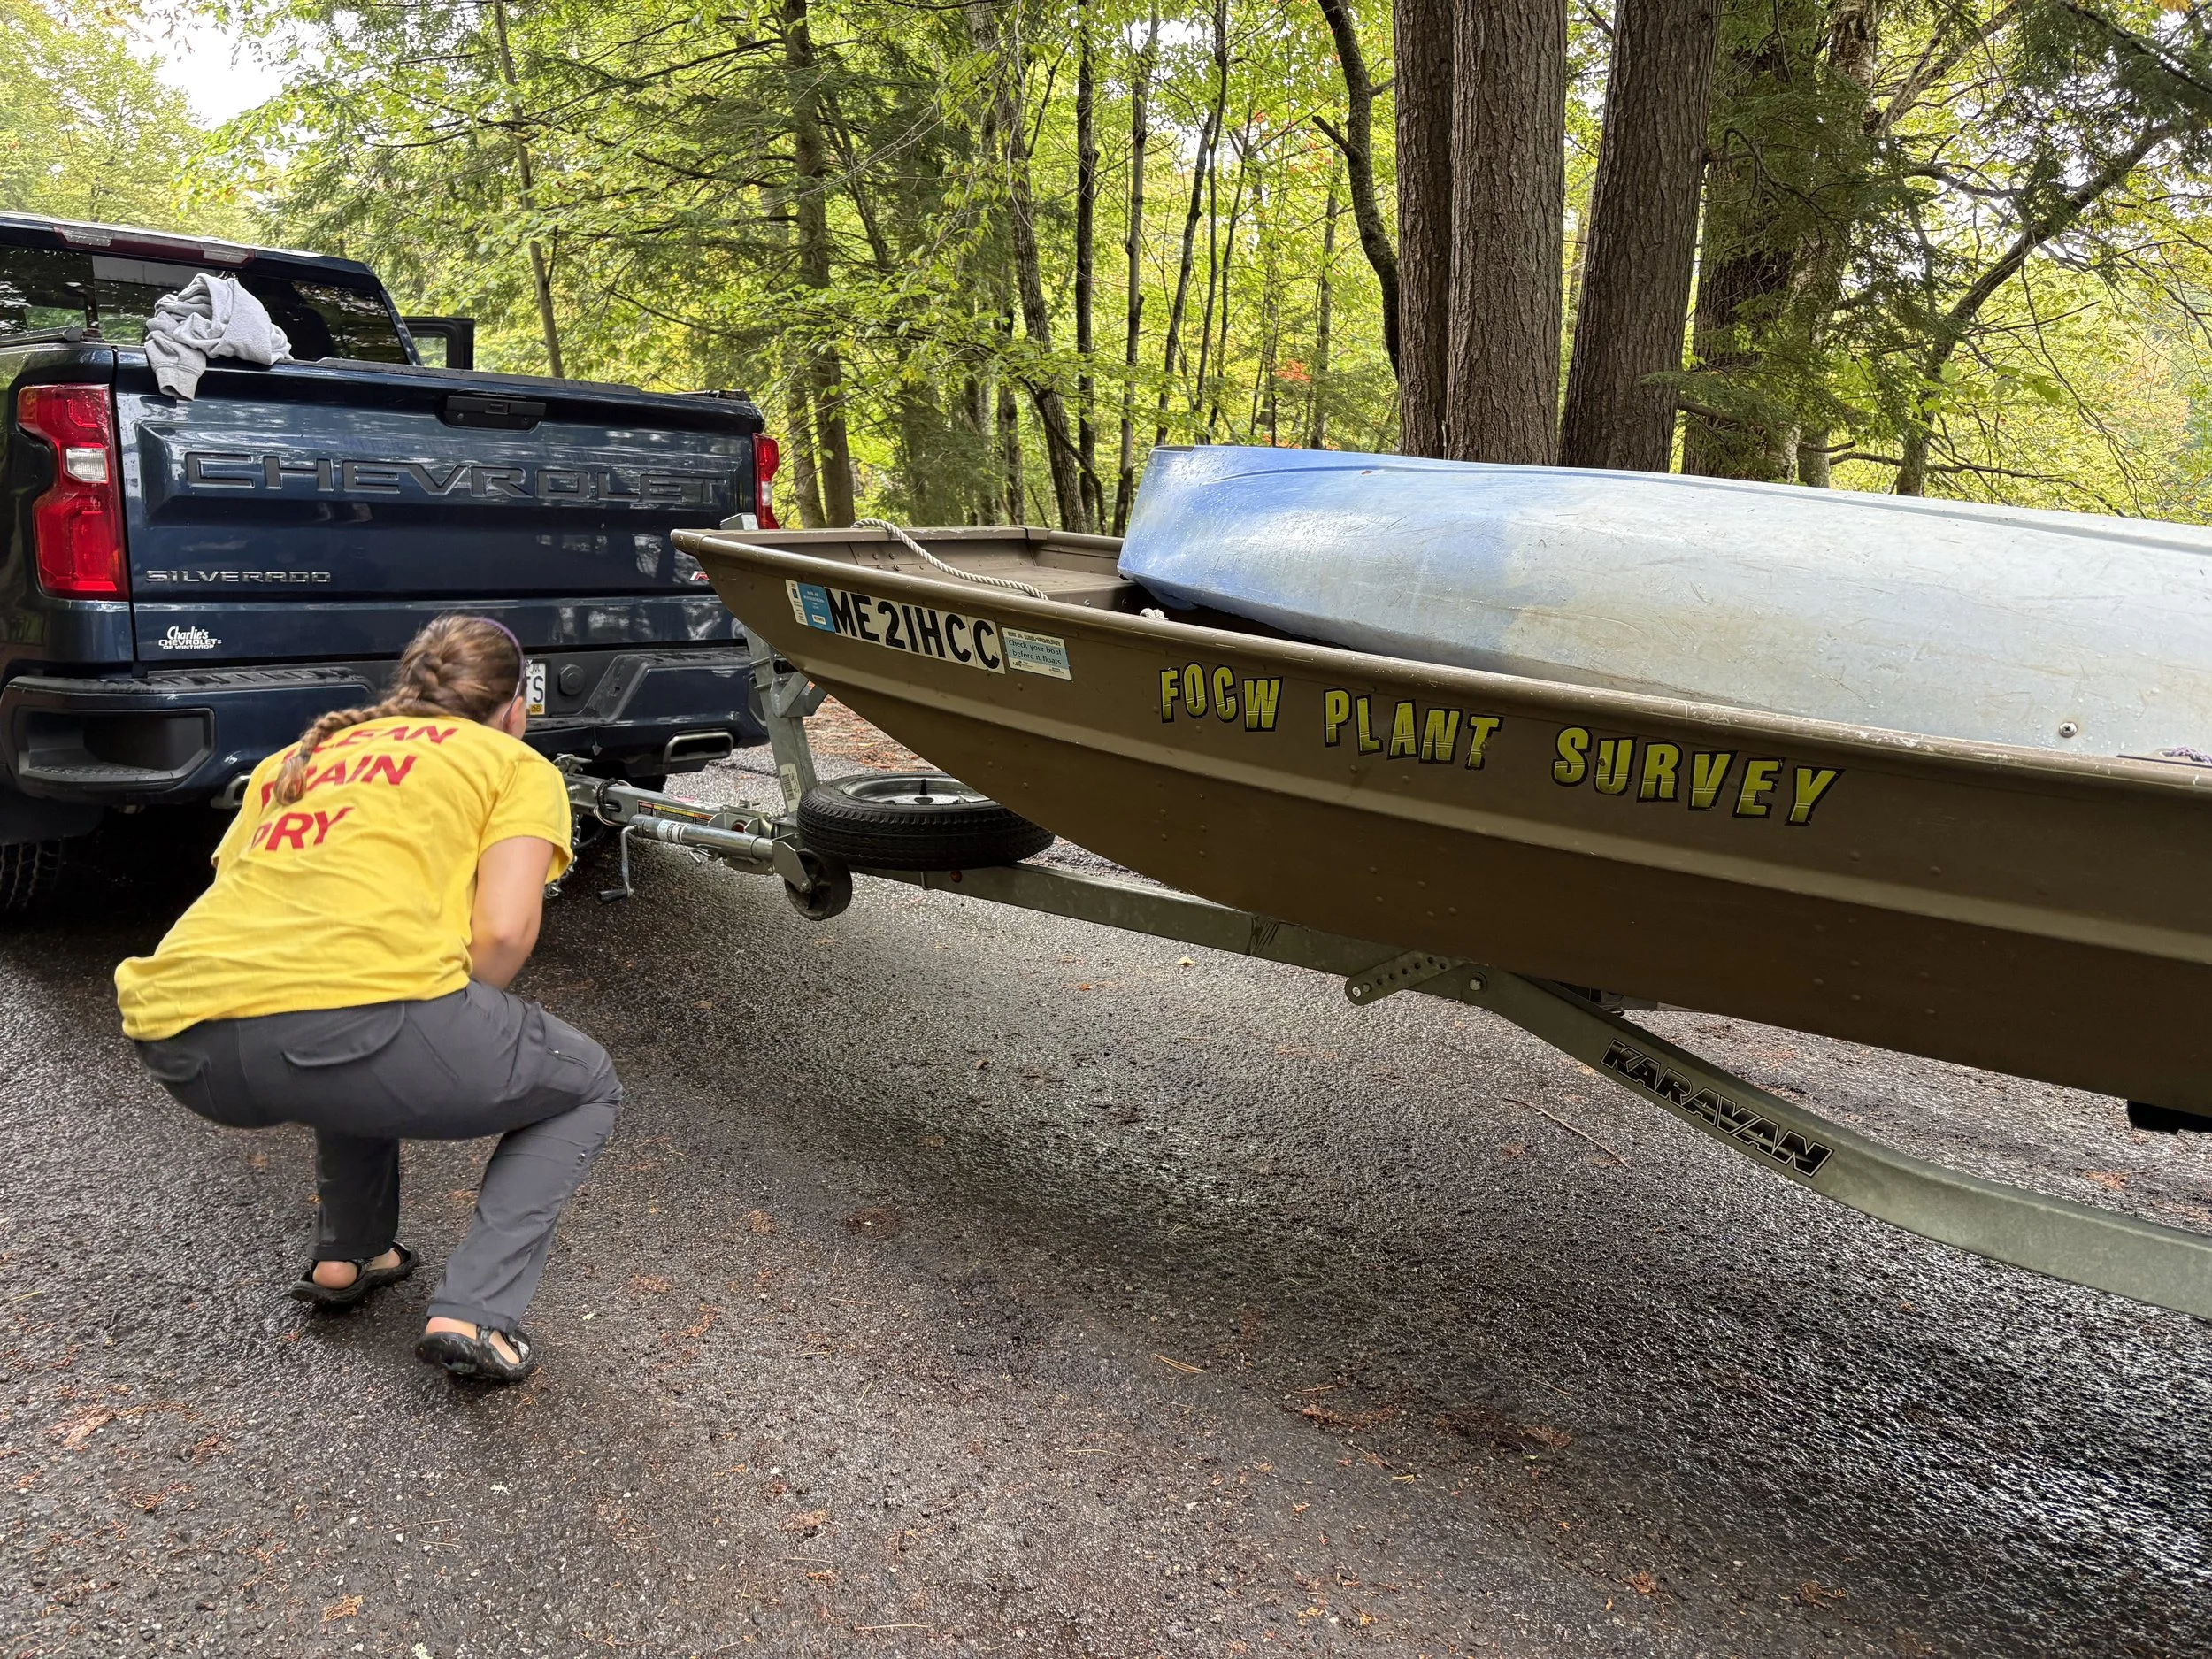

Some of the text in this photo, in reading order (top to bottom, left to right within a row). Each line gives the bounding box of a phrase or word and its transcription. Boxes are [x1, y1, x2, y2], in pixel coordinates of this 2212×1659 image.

[183, 449, 726, 505] CHEVROLET
[145, 570, 332, 583] SILVERADO
[166, 626, 209, 640] Charlie's
[1008, 639, 1028, 649] Check
[1046, 646, 1062, 657] boat
[1011, 649, 1035, 660] before
[1042, 655, 1063, 665] floats
[1160, 664, 1845, 826] FOCW PLANT SURVEY
[250, 806, 356, 852] DRY
[1600, 1038, 1835, 1178] KARAVAN
